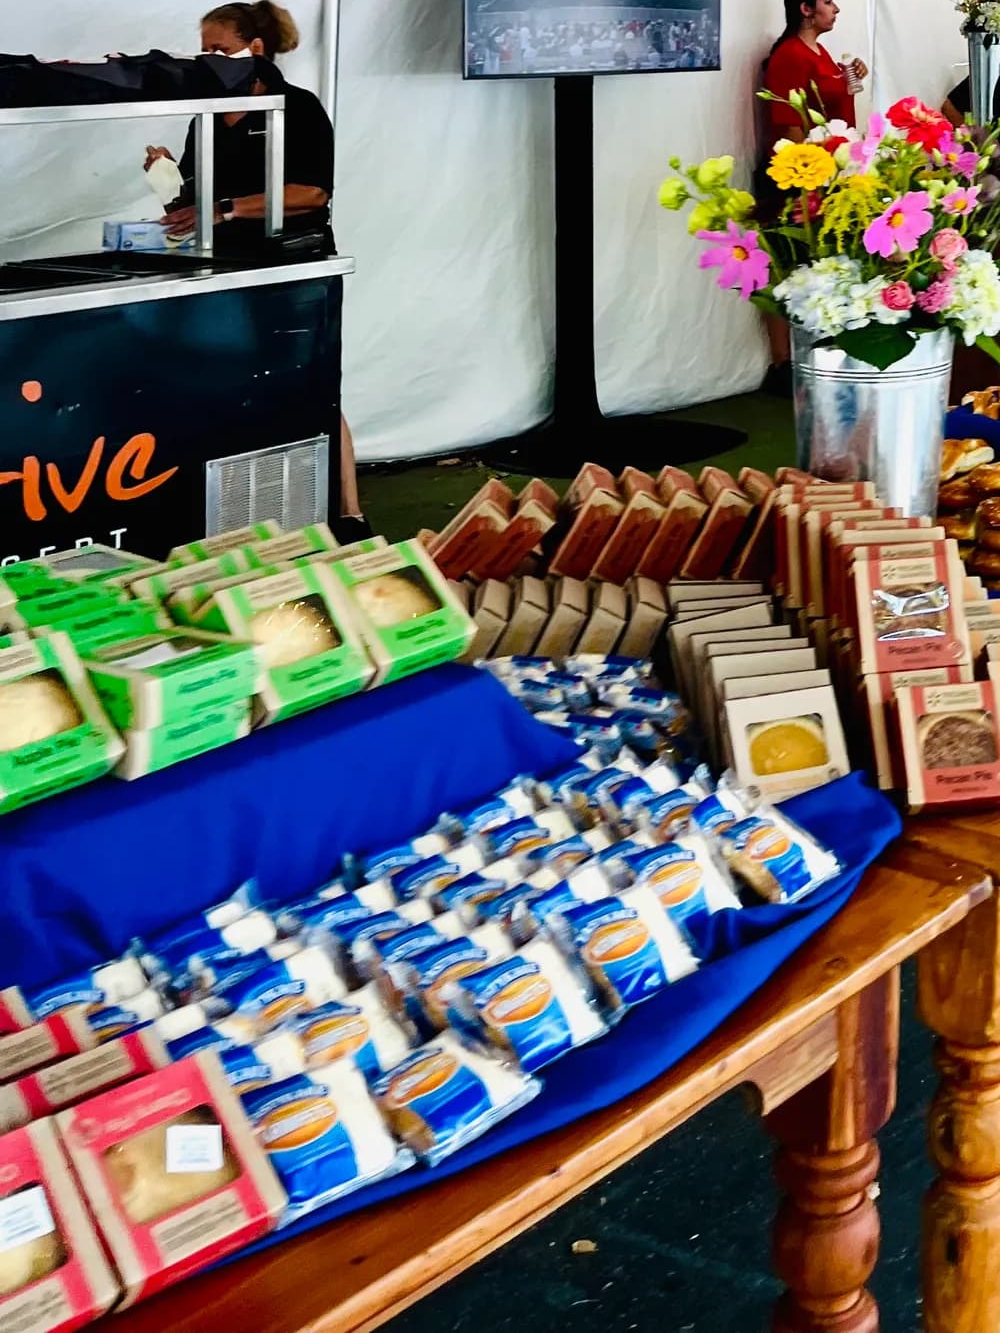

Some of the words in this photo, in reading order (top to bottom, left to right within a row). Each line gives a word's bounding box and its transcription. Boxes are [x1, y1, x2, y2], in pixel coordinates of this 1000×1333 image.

[924, 641, 942, 652] Pie
[935, 773, 971, 785] Pecan
[973, 770, 993, 781] Pie
